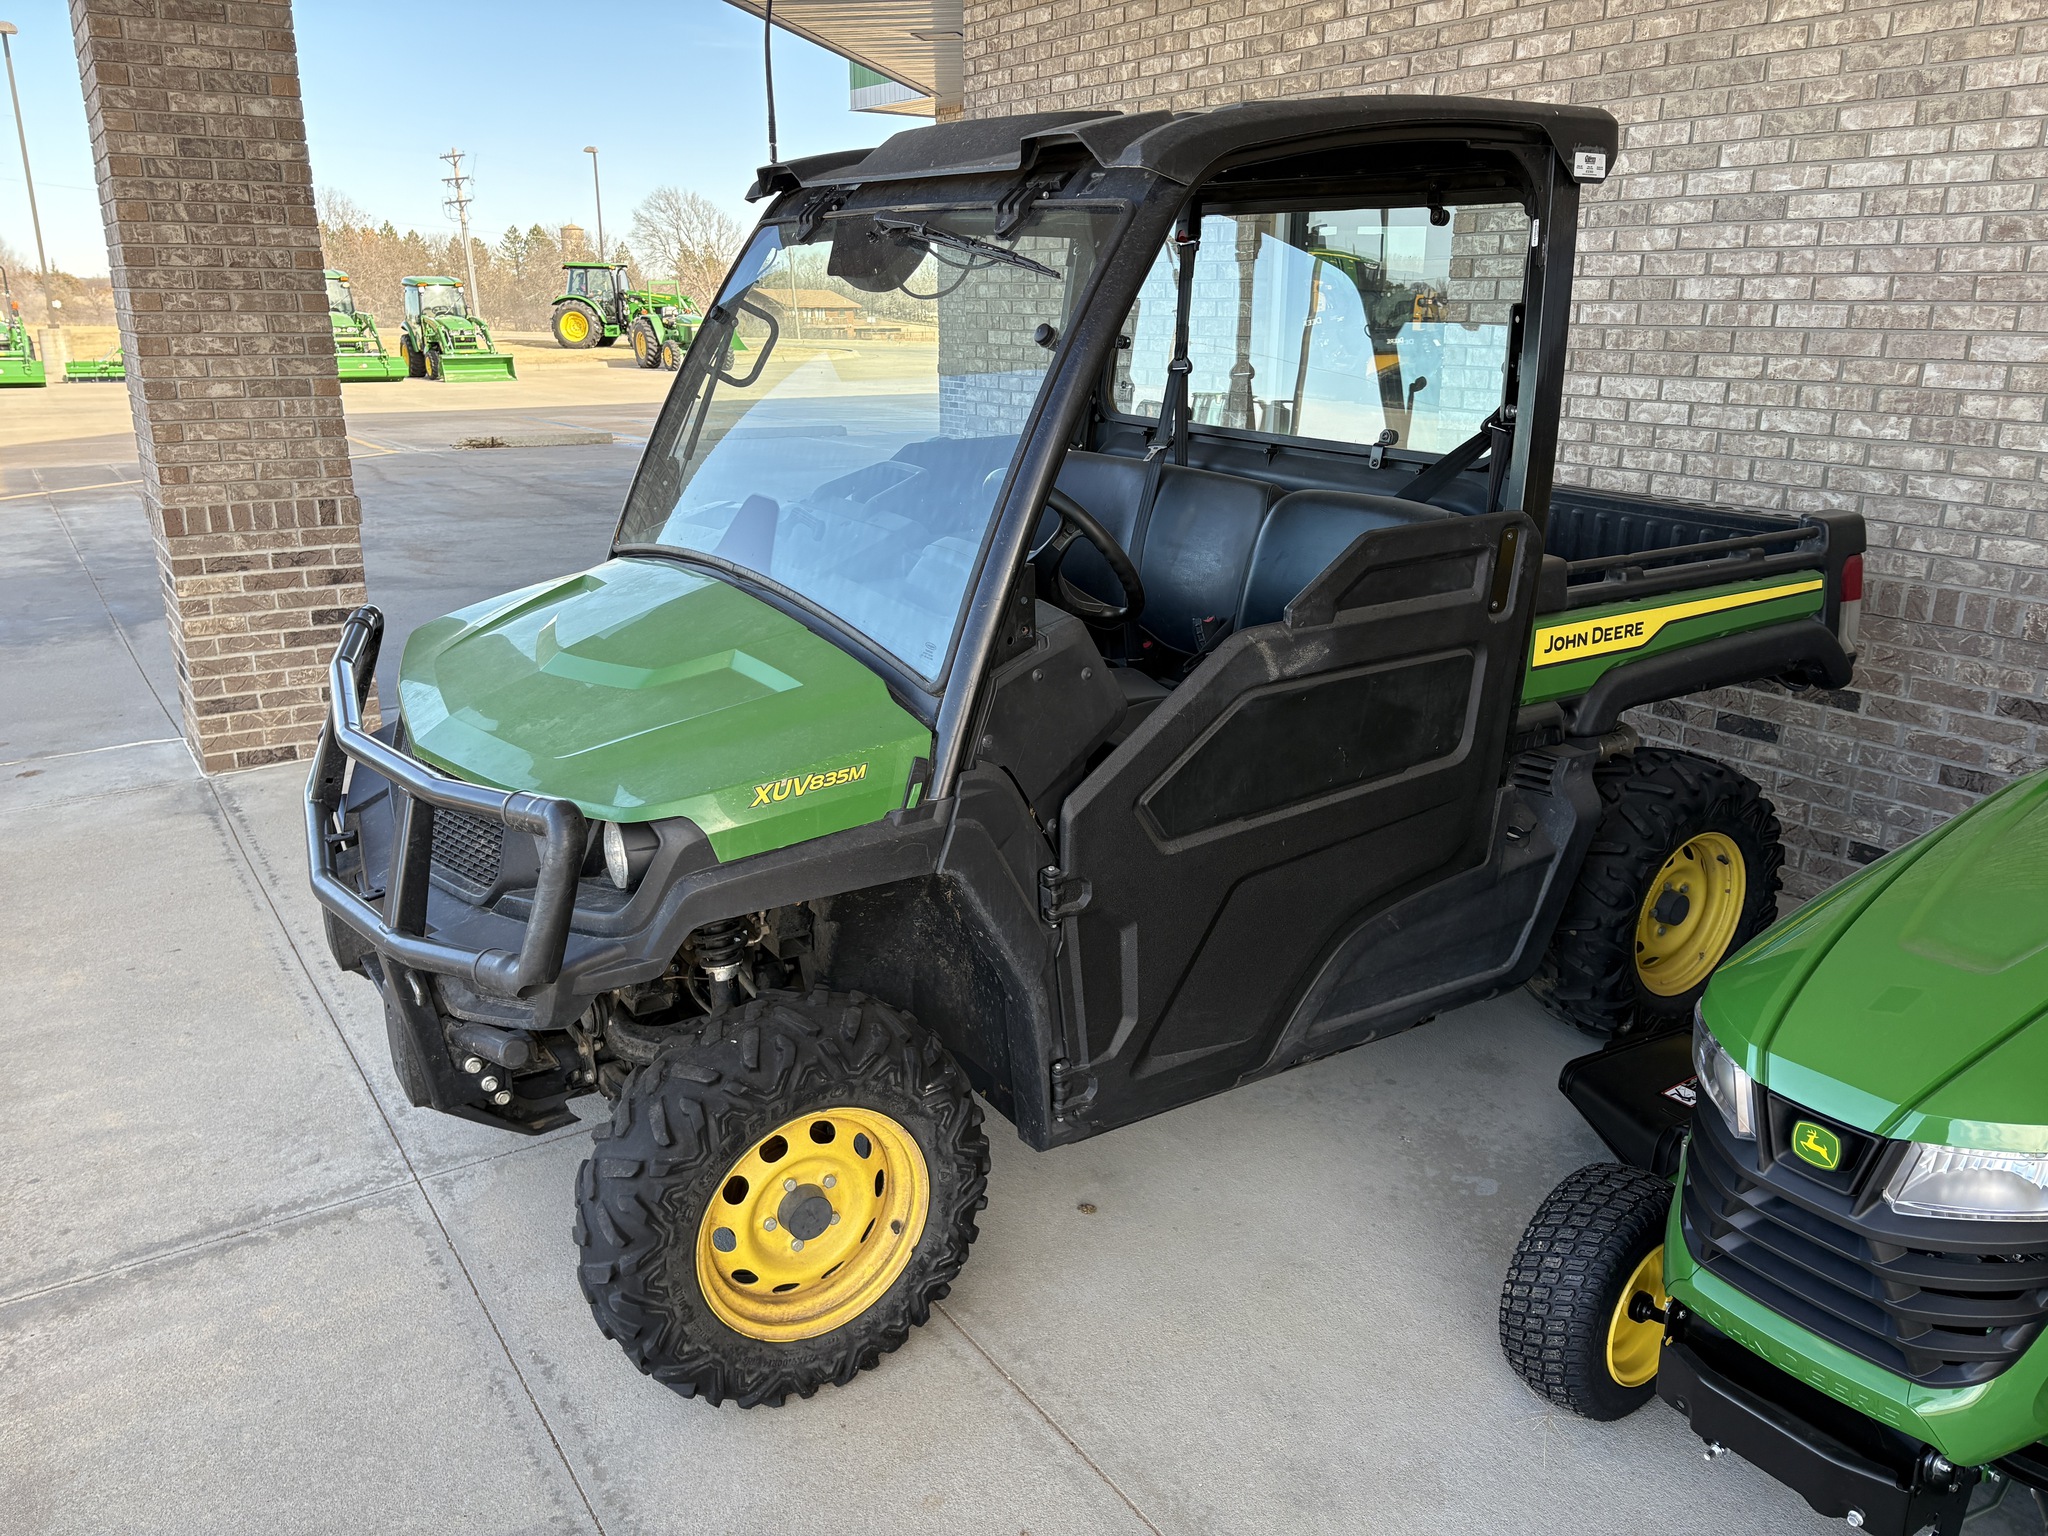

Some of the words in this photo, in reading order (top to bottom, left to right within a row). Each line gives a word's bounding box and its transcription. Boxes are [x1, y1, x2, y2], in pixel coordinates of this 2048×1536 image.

[1544, 631, 1588, 654] JOHN
[1592, 621, 1644, 644] DEERE
[749, 762, 868, 808] XUV835M
[1778, 1346, 1901, 1427] DEERE
